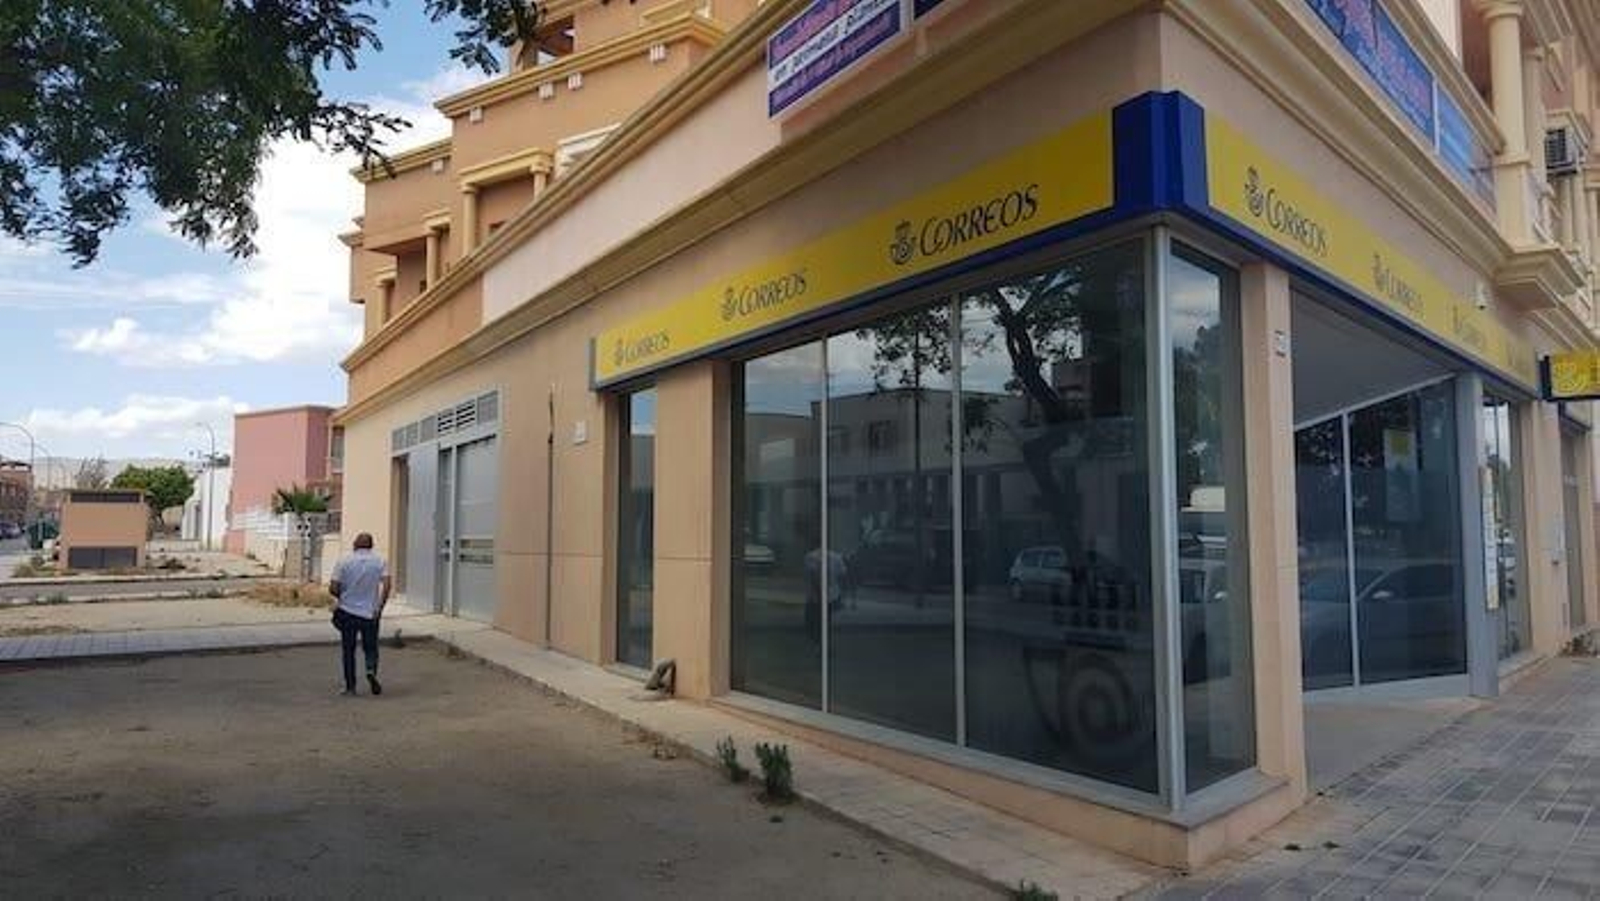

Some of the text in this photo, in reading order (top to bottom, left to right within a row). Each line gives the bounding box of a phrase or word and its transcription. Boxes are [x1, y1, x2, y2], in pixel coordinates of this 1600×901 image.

[920, 184, 1038, 256] CORREOS
[1267, 188, 1328, 257] CORREOS
[739, 270, 807, 316] CORREOS
